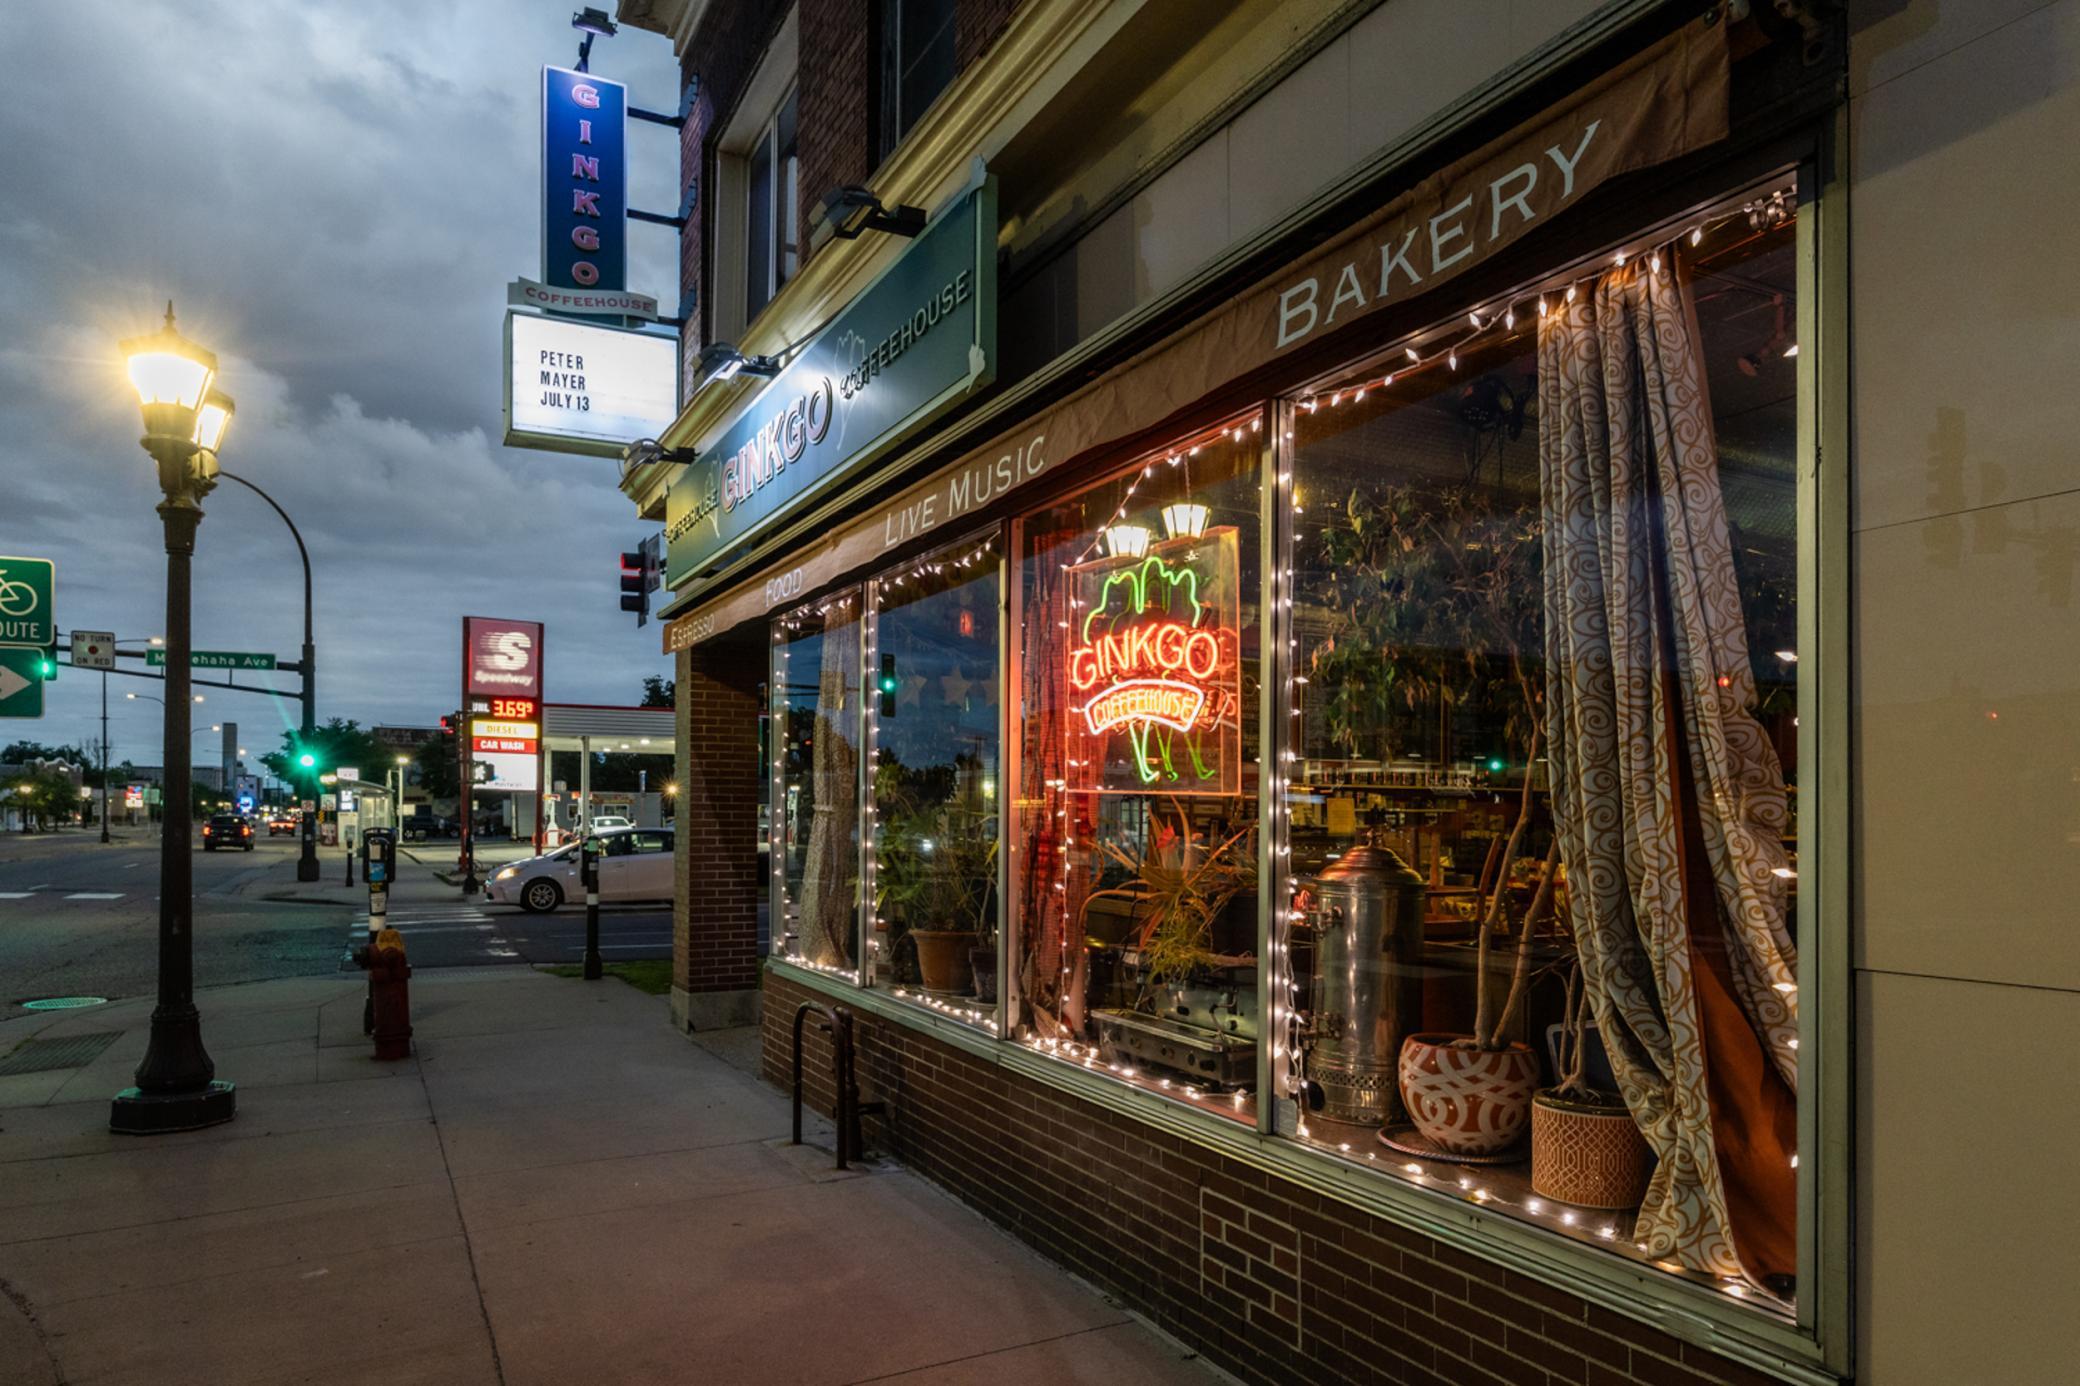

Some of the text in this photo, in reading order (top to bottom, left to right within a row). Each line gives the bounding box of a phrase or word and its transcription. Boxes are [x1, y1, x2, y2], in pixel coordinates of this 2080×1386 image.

[570, 83, 600, 286] GINKGO
[1275, 119, 1602, 350] BAKERY
[525, 286, 654, 313] COFFEEHOUSE
[839, 269, 972, 400] COFFEEHOUSE
[540, 350, 584, 370] PETER
[540, 371, 586, 391] MAYER
[540, 392, 590, 412] JULY 13
[719, 376, 833, 514] GINKGO
[884, 435, 1045, 548] LIVE MUSIC
[765, 567, 802, 608] FOOD
[74, 634, 111, 643] NO TURN
[671, 614, 715, 649] ESPRESSO
[76, 657, 110, 666] ON RED
[154, 653, 268, 666] Mehaha Ave
[1072, 623, 1218, 690] GINKGO
[474, 669, 533, 687] Speedway
[1092, 687, 1197, 726] COFFEEHOUSE
[486, 725, 518, 736] DIESEL
[480, 740, 525, 751] CAR WASH
